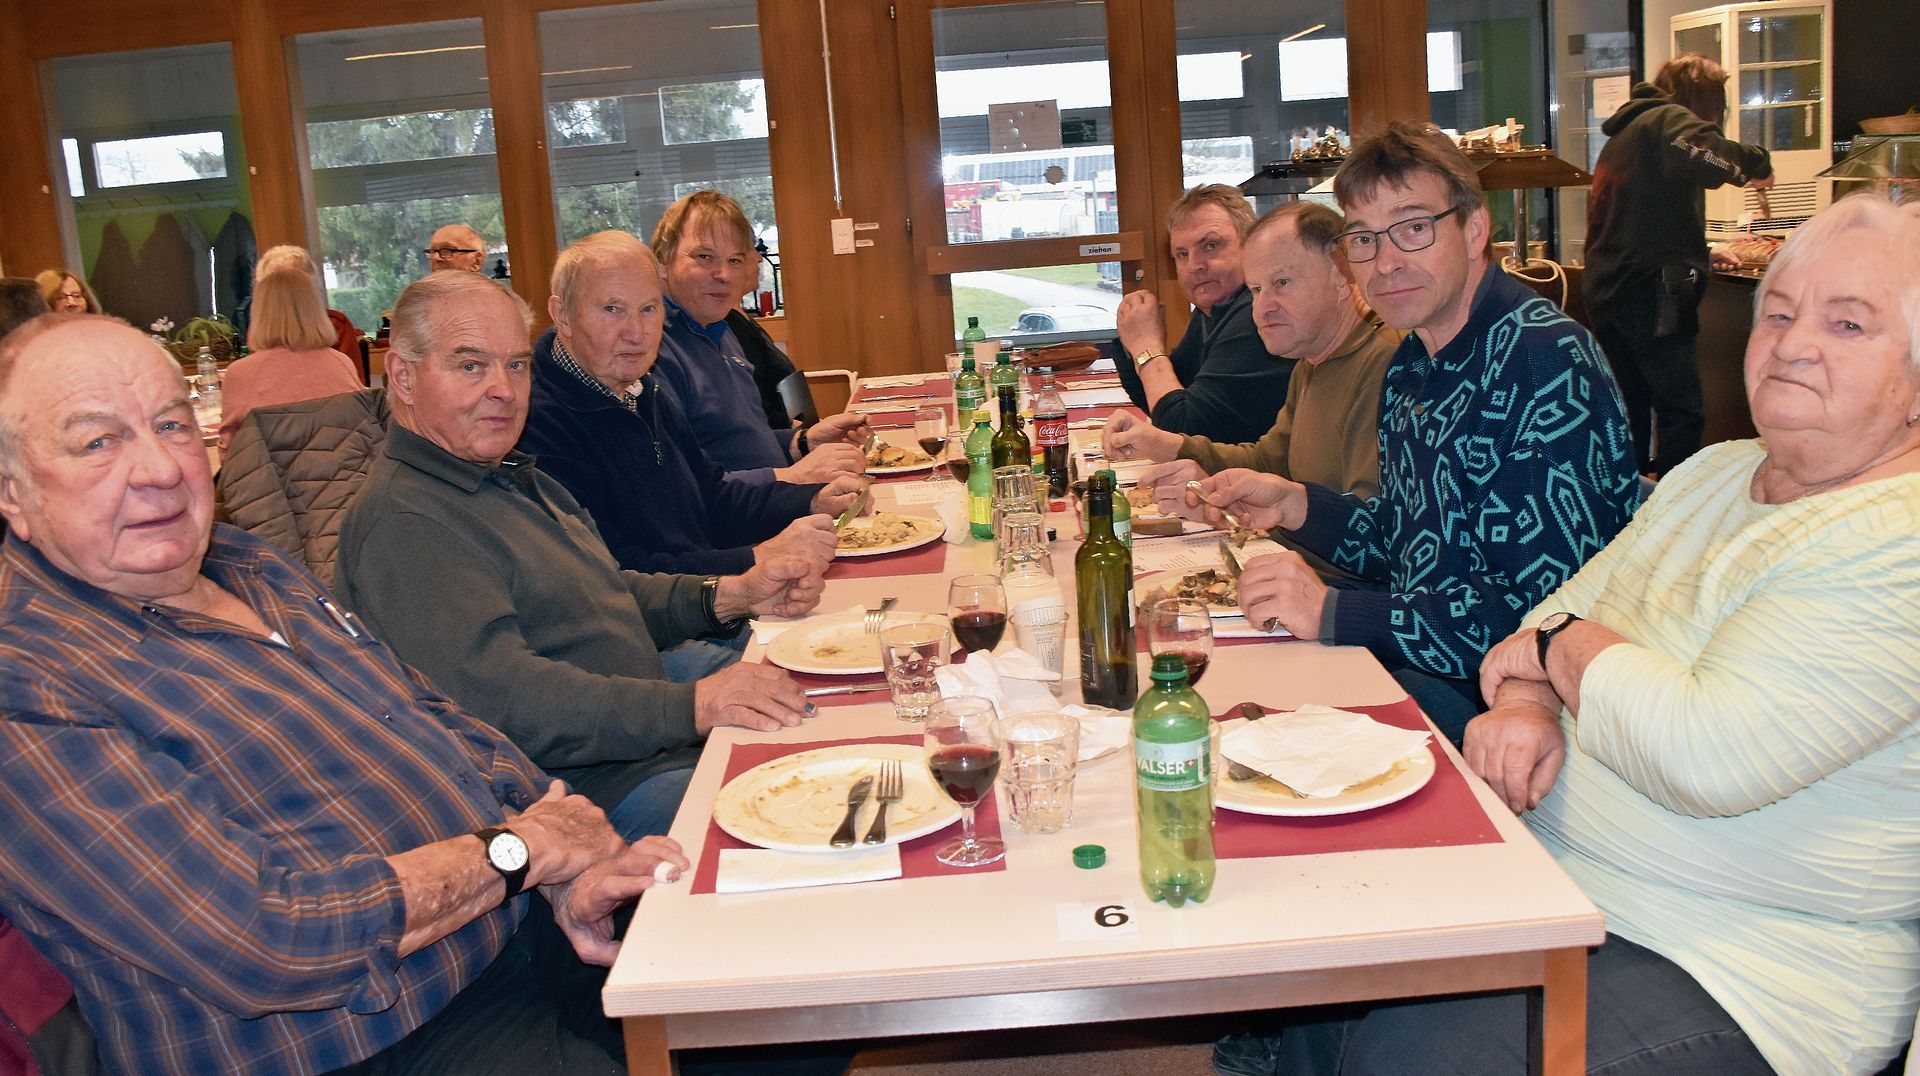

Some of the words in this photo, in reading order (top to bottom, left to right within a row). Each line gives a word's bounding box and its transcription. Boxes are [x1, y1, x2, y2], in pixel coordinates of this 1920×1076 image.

[1088, 246, 1112, 254] ziehen
[1137, 758, 1186, 775] VALSER
[1094, 905, 1129, 928] 6
